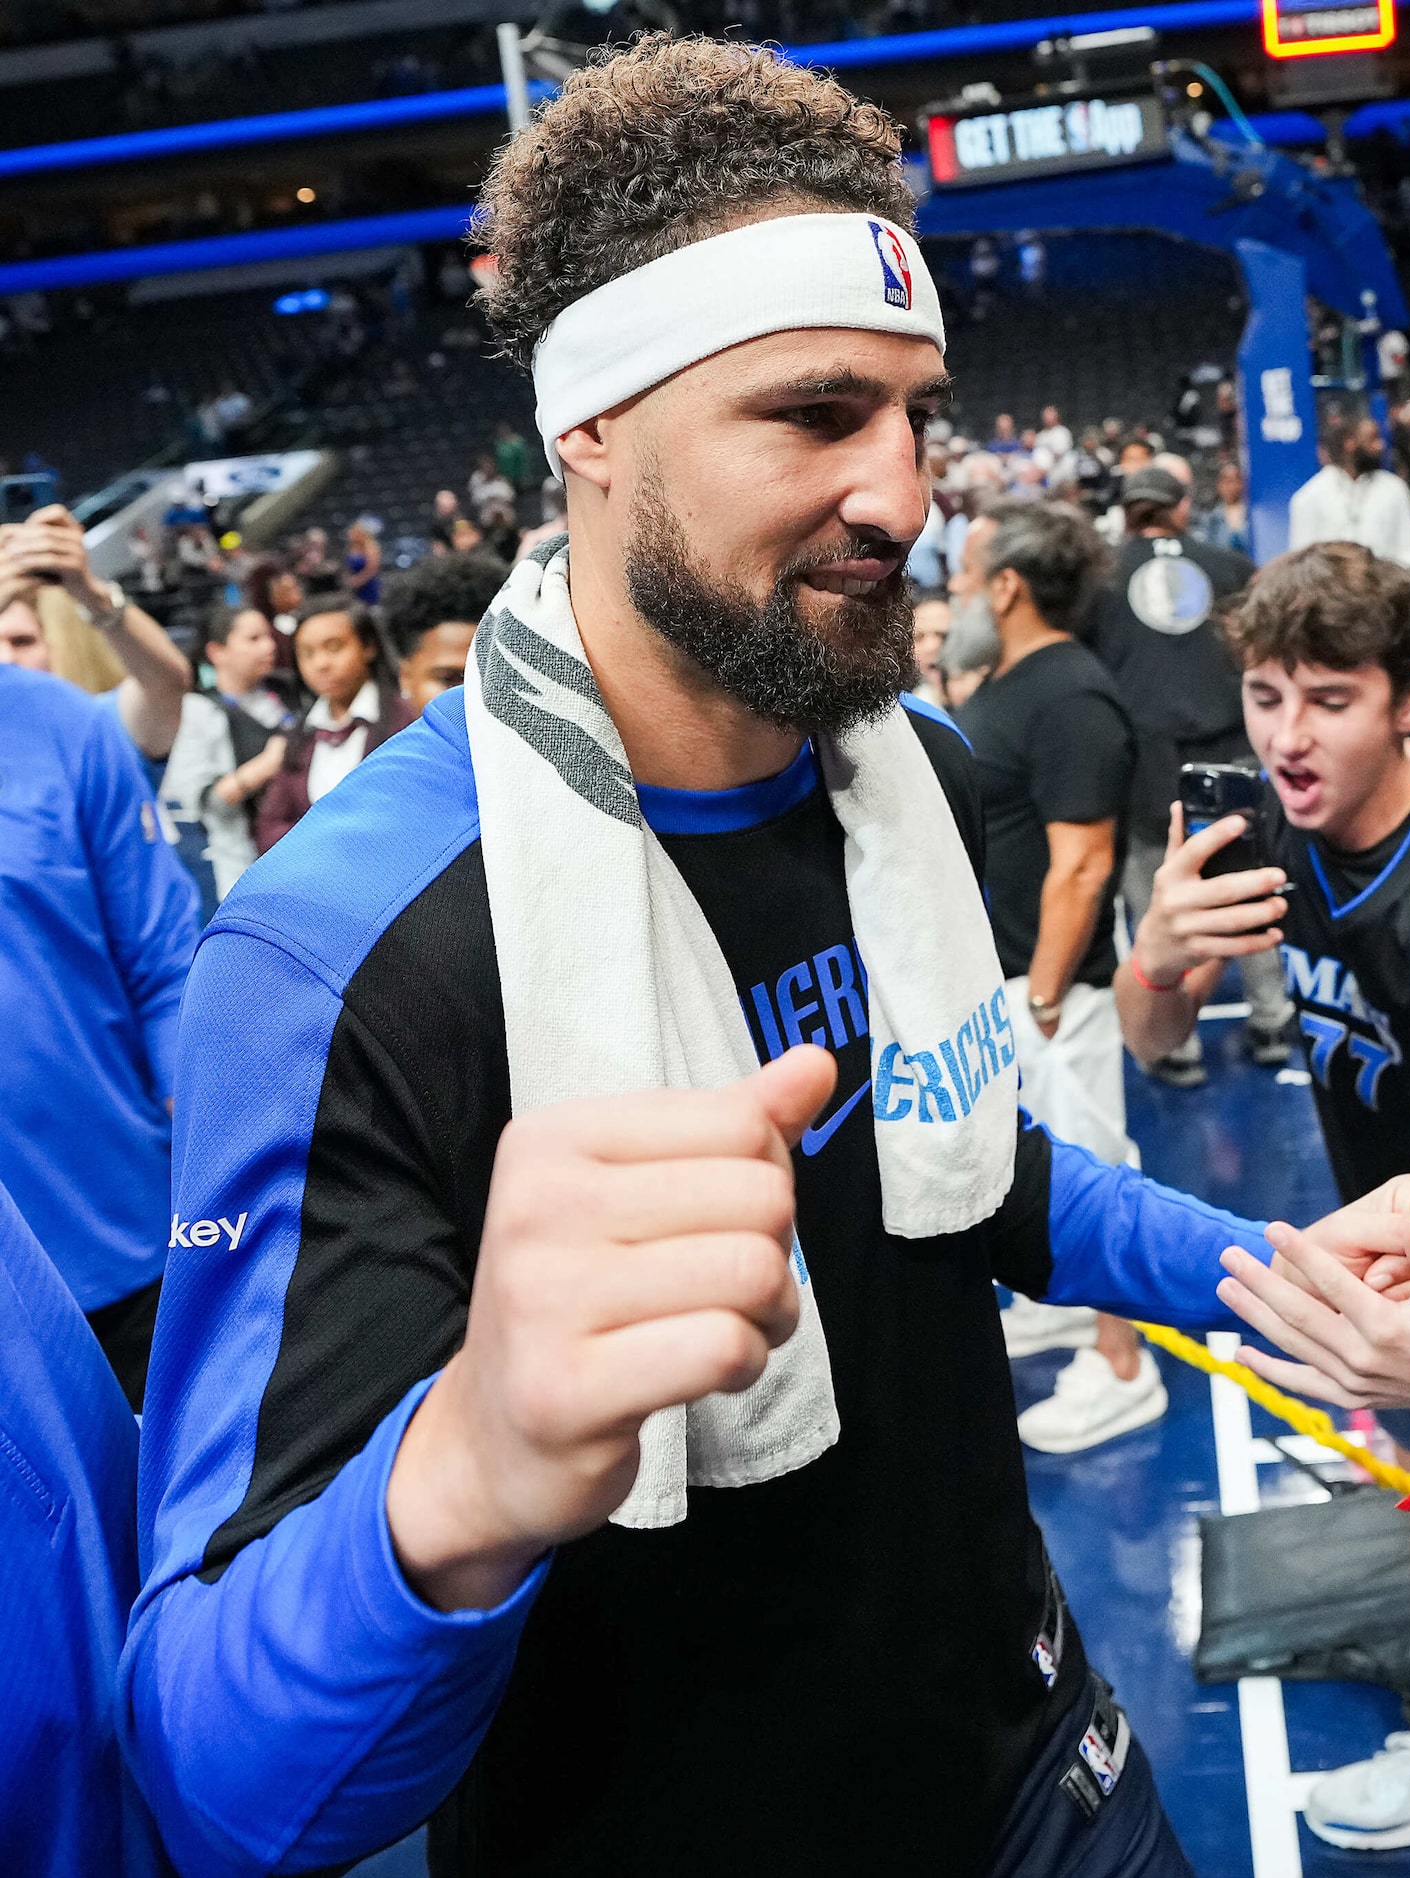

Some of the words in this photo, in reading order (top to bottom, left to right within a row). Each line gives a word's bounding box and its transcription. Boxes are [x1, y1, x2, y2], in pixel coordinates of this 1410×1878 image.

[886, 287, 906, 305] NBA
[870, 984, 1016, 1124] ERICKS
[1300, 1009, 1393, 1112] 77
[167, 1211, 248, 1251] key
